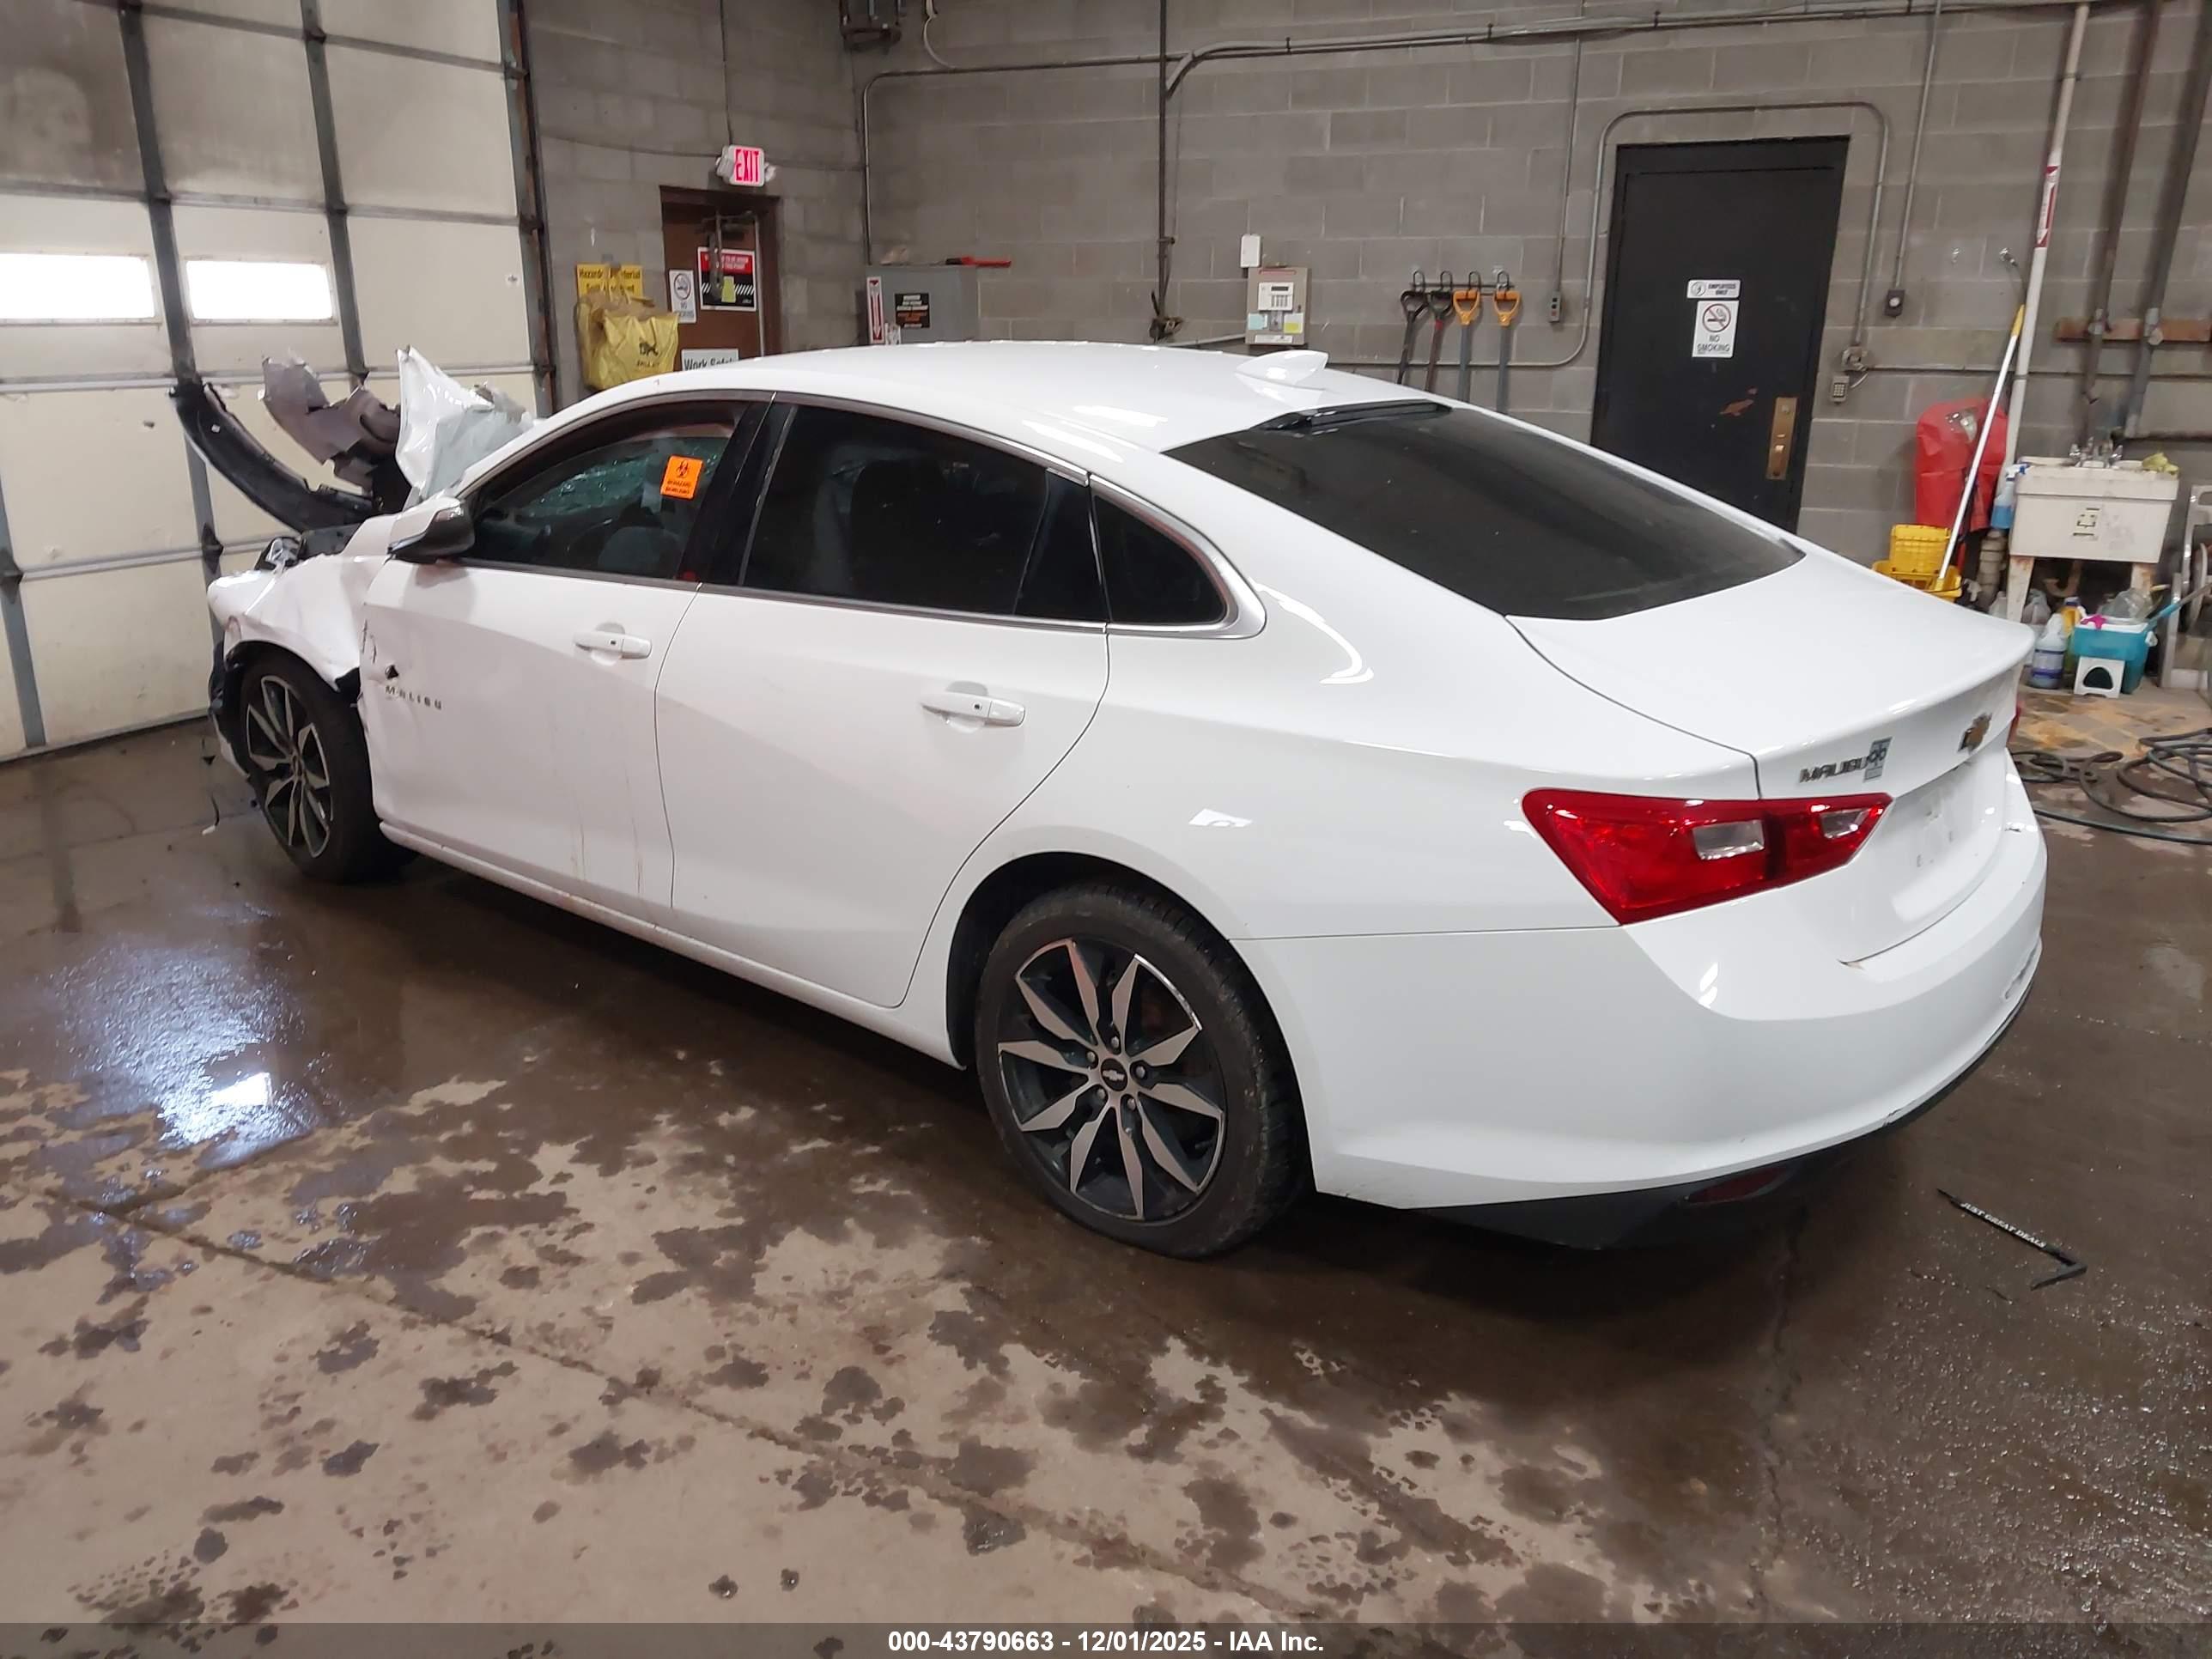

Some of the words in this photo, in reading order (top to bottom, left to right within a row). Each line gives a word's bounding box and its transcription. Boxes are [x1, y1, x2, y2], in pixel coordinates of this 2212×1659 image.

[736, 149, 759, 182] EXIT
[684, 358, 708, 371] Work
[1799, 757, 1868, 784] MALIBU
[1960, 1202, 1986, 1216] JUST
[1984, 1214, 2017, 1232] GREAT
[2015, 1229, 2047, 1249] DEALS
